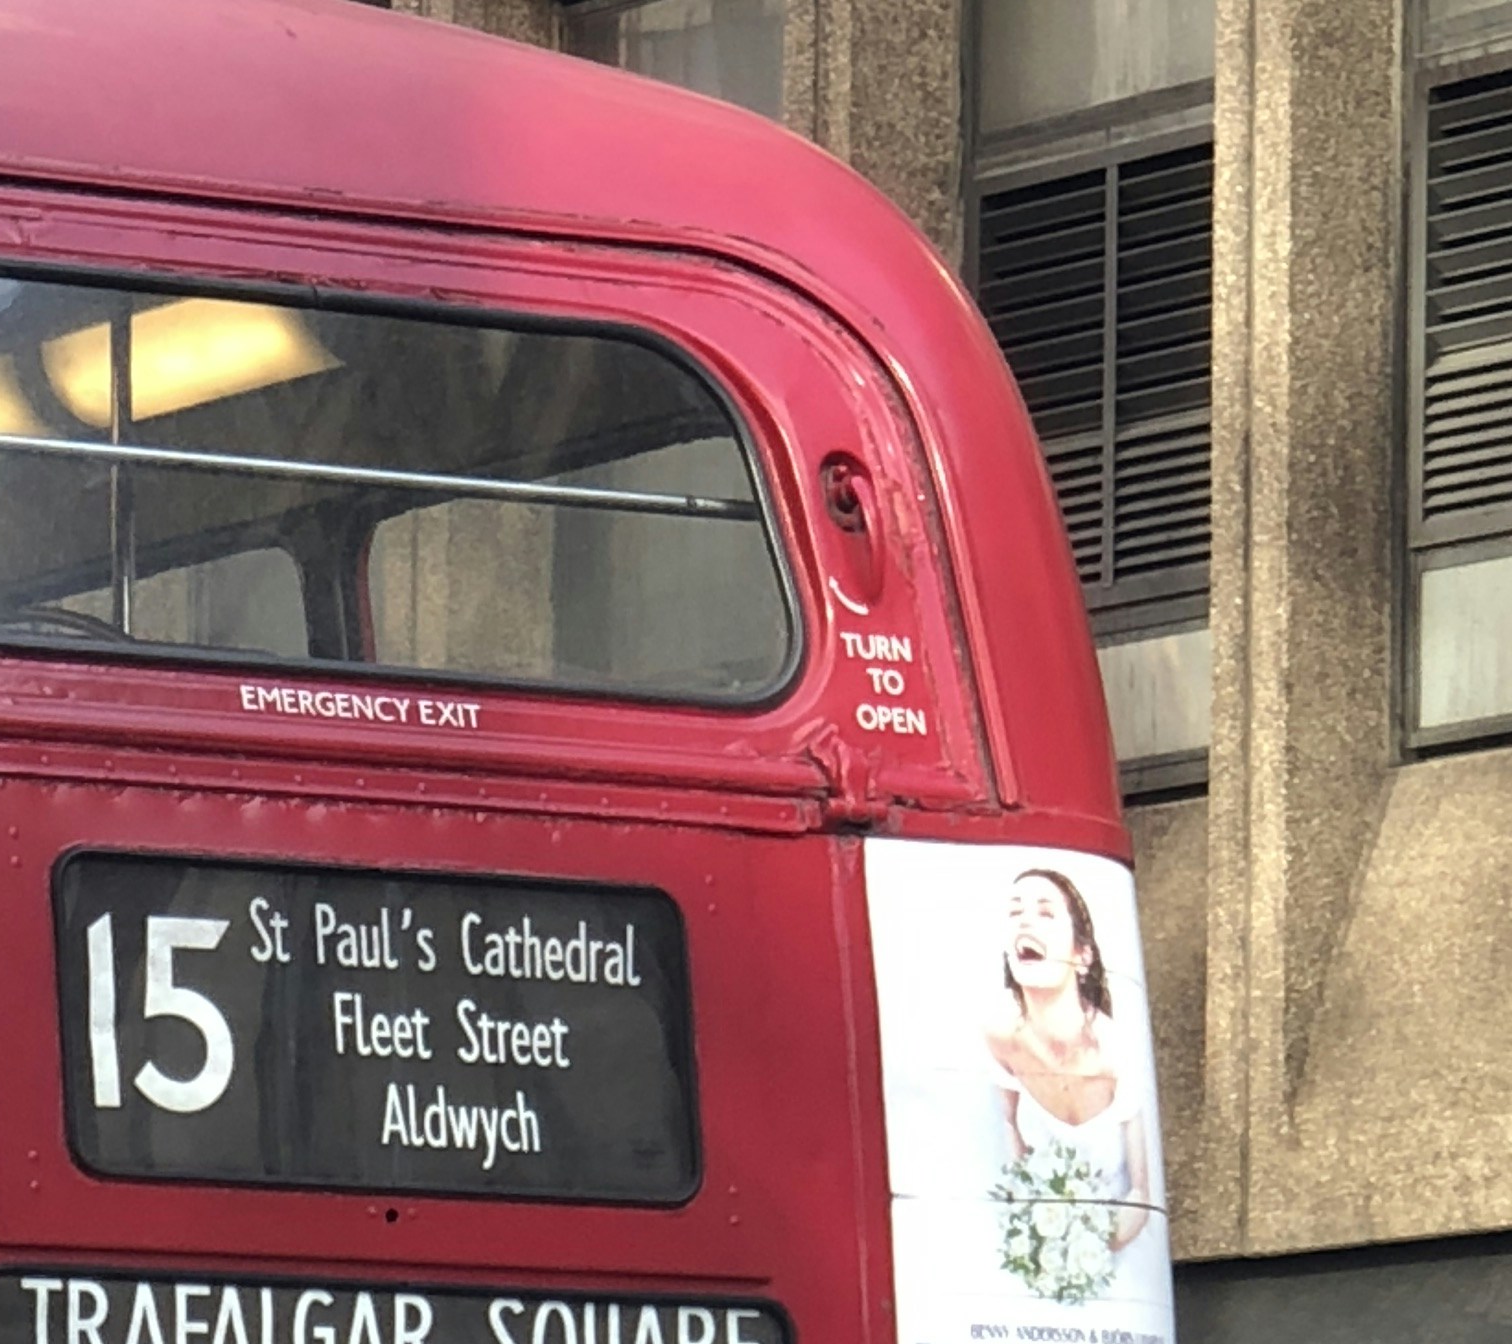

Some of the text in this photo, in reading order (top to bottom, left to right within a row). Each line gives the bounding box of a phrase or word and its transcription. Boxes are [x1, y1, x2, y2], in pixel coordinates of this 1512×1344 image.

[841, 632, 912, 662] TURN
[240, 685, 480, 729] EMERGENCY EXIT
[867, 669, 903, 695] TO
[857, 704, 926, 735] OPEN
[250, 897, 641, 986] St Paul's Cathedral
[88, 911, 234, 1113] 15
[334, 992, 569, 1070] Fleet Street
[381, 1085, 539, 1167] Aldwych
